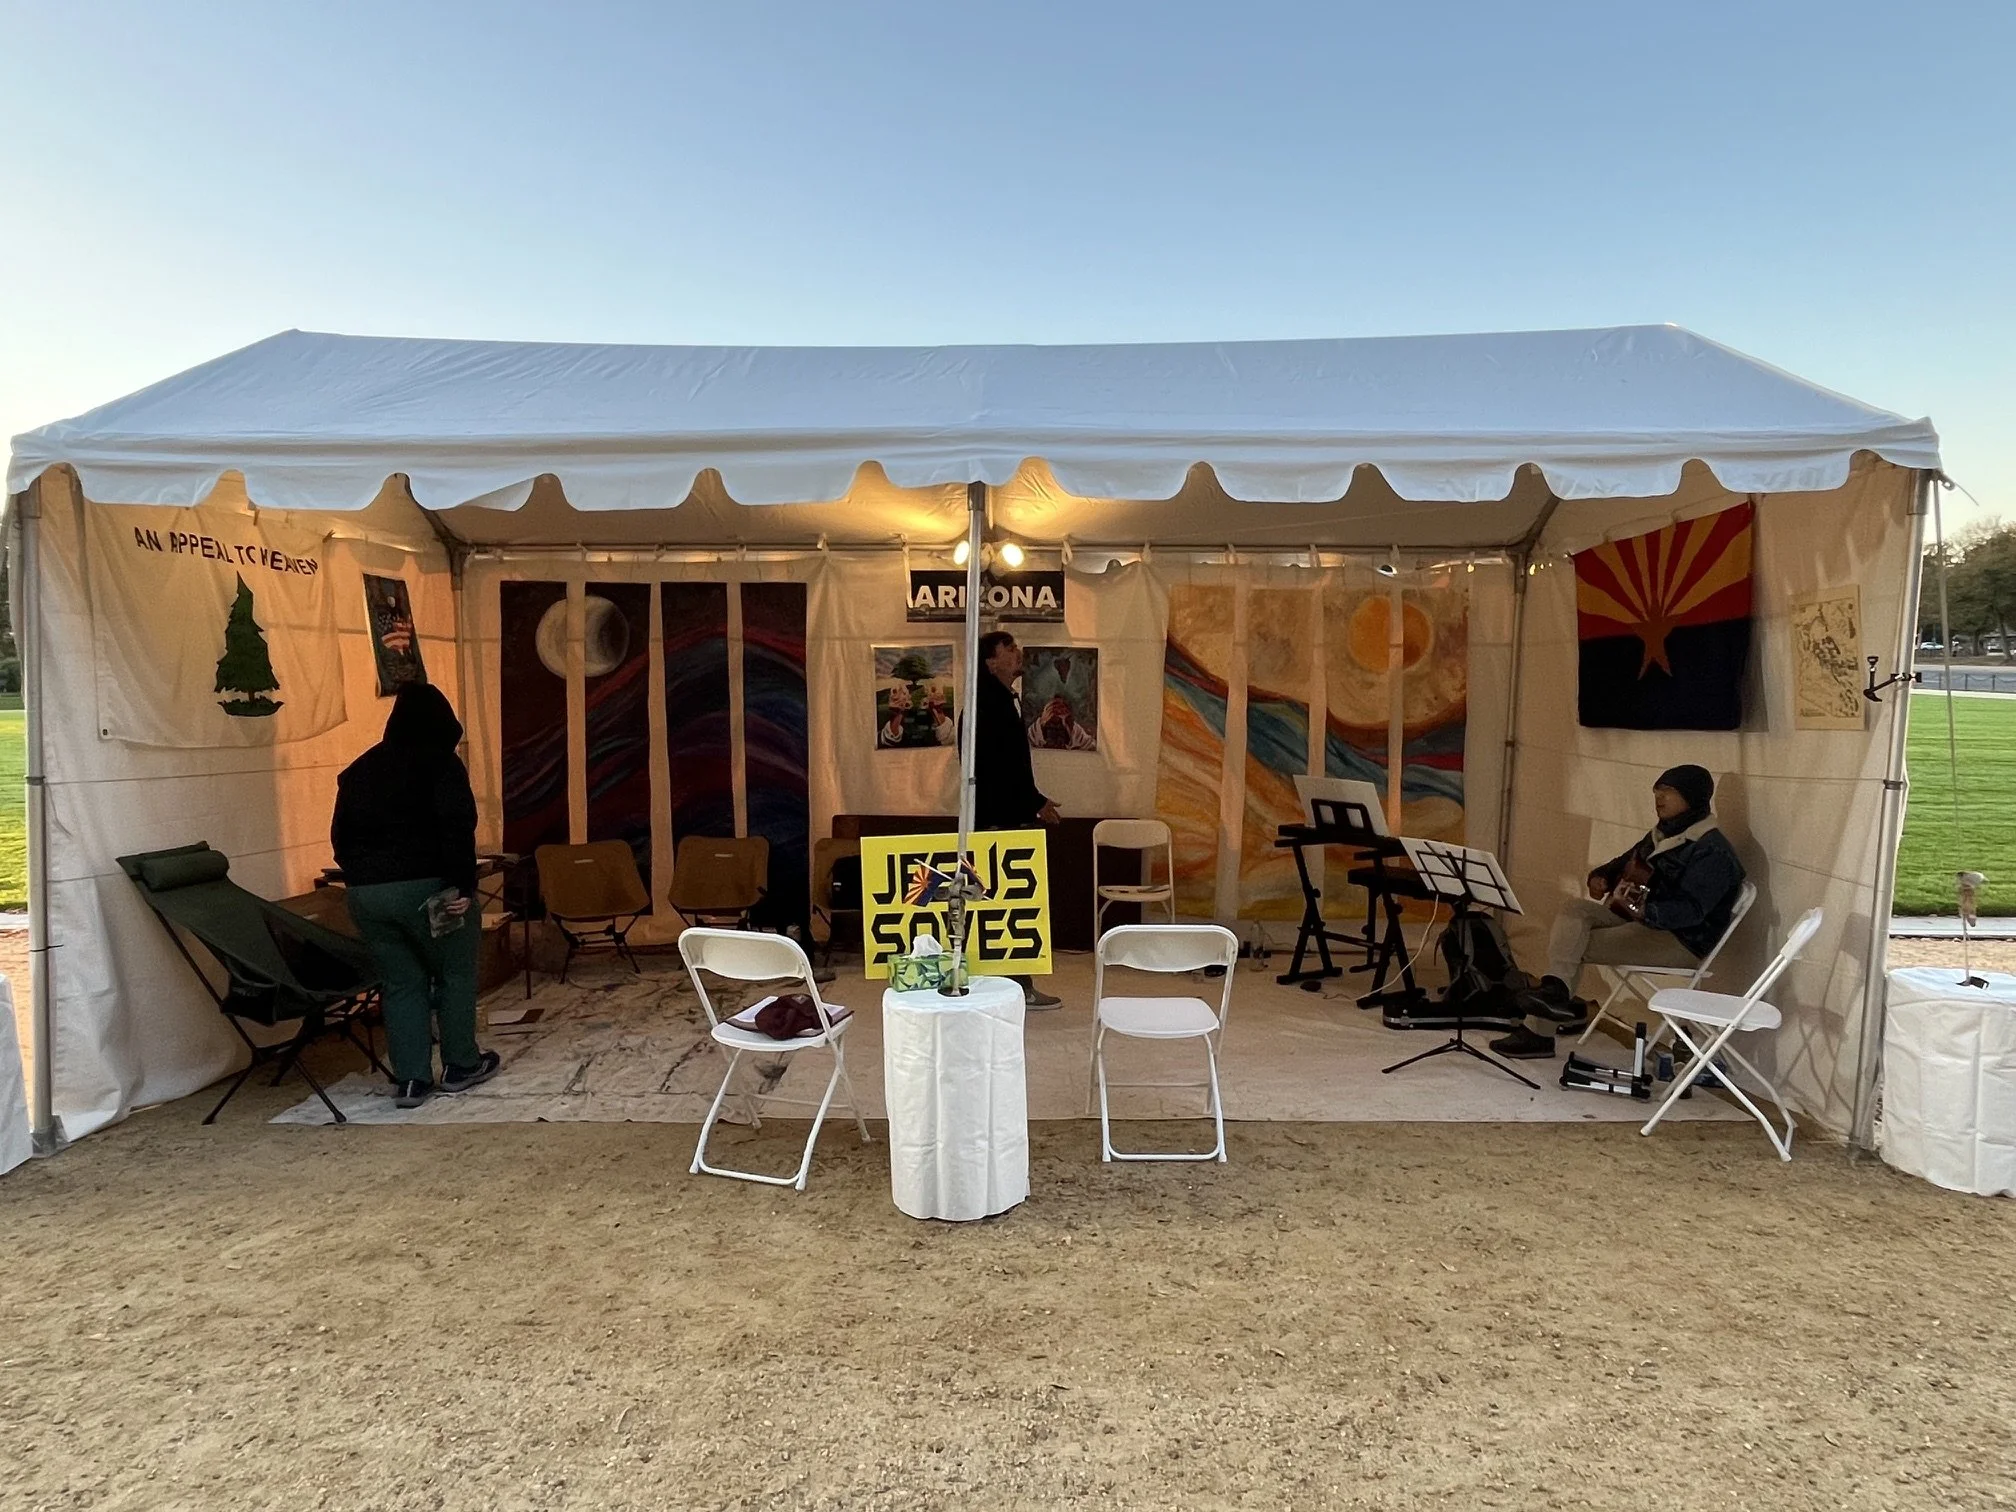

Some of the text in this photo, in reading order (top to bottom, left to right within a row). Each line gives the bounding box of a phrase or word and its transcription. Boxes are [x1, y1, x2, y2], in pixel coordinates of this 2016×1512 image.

[134, 526, 163, 552] AN
[169, 531, 234, 564] APPEAL
[260, 546, 318, 575] HEAVEN
